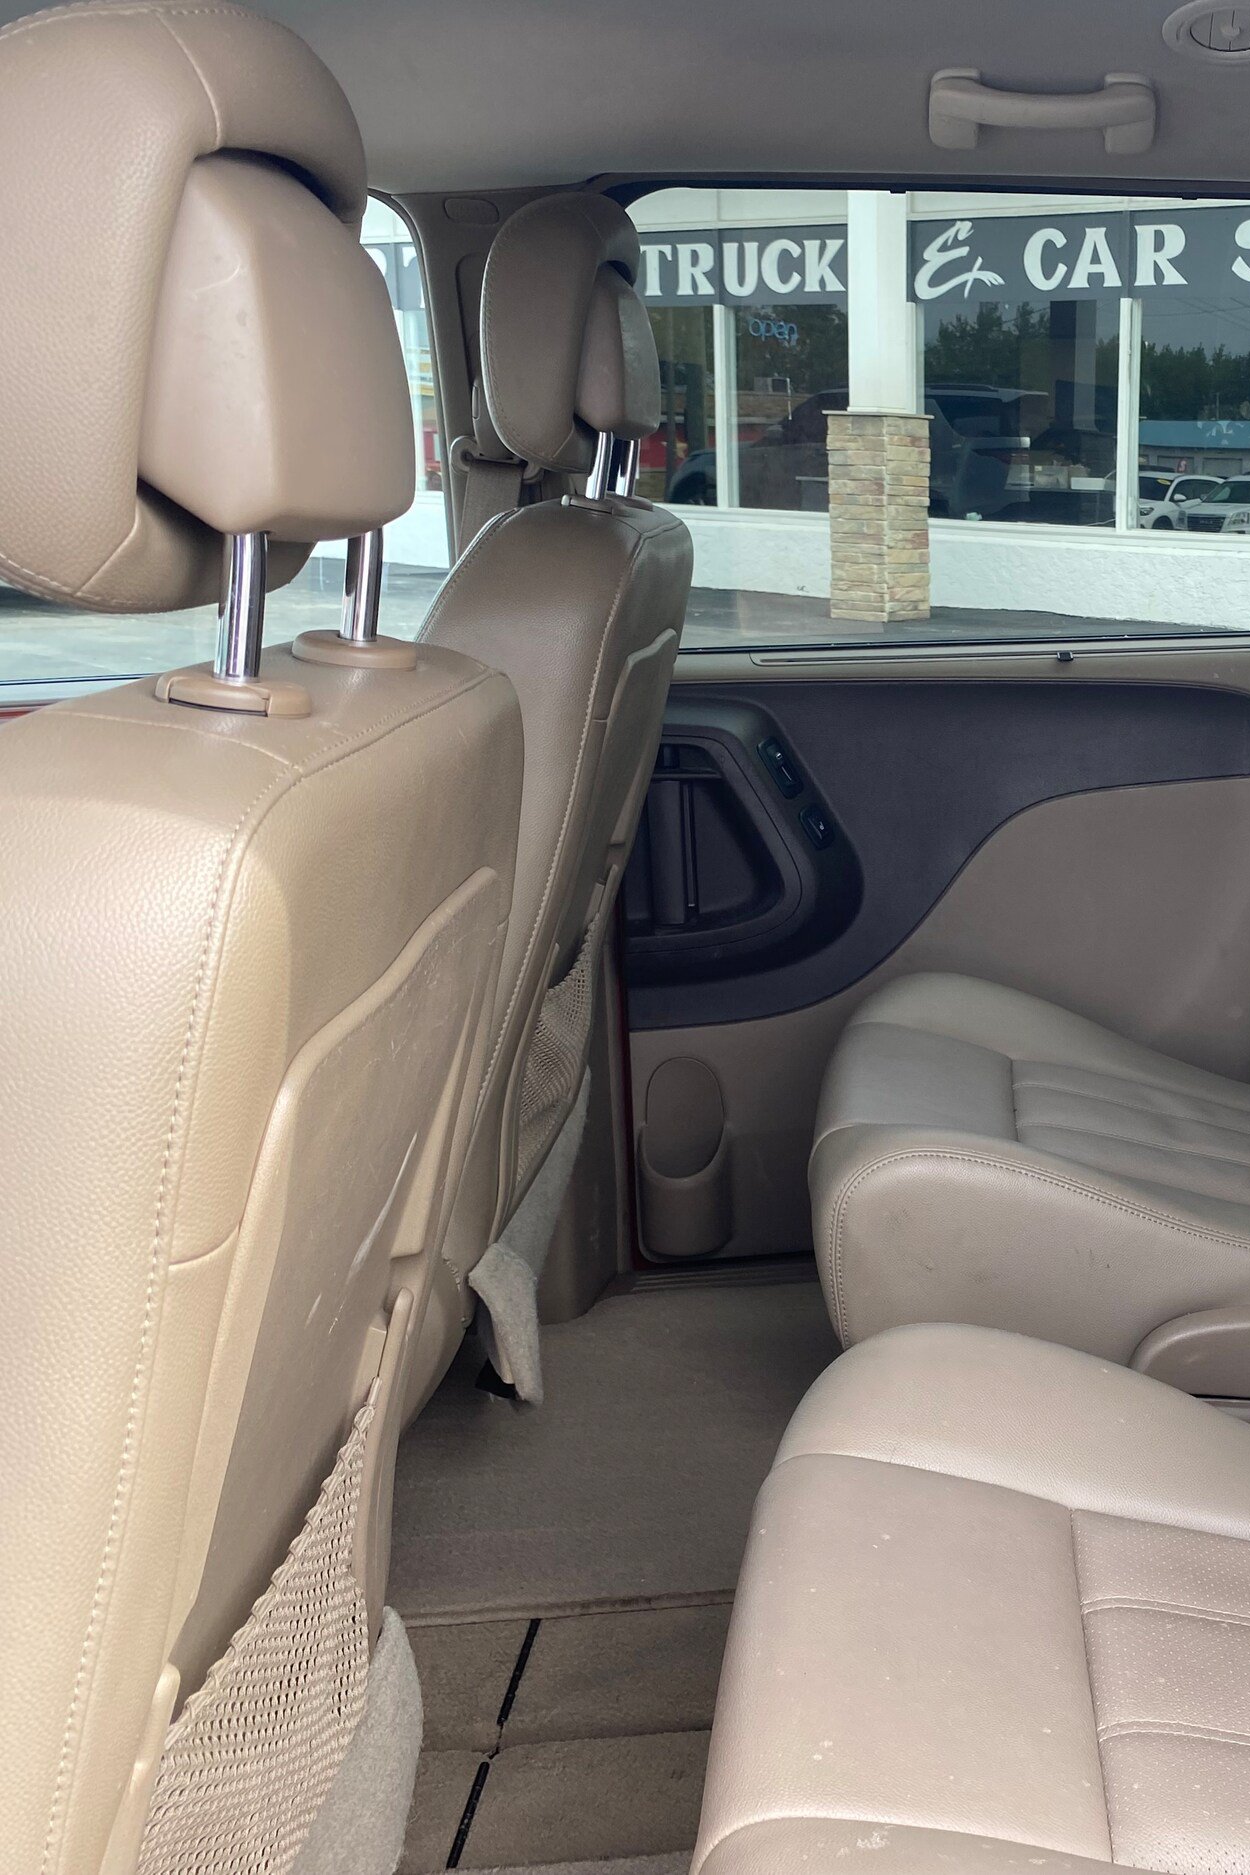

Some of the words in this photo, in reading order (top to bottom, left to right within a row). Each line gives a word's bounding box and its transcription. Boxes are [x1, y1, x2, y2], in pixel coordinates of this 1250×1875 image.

[640, 238, 846, 297] TRUCK
[914, 220, 1005, 299] &
[1023, 223, 1188, 291] CAR
